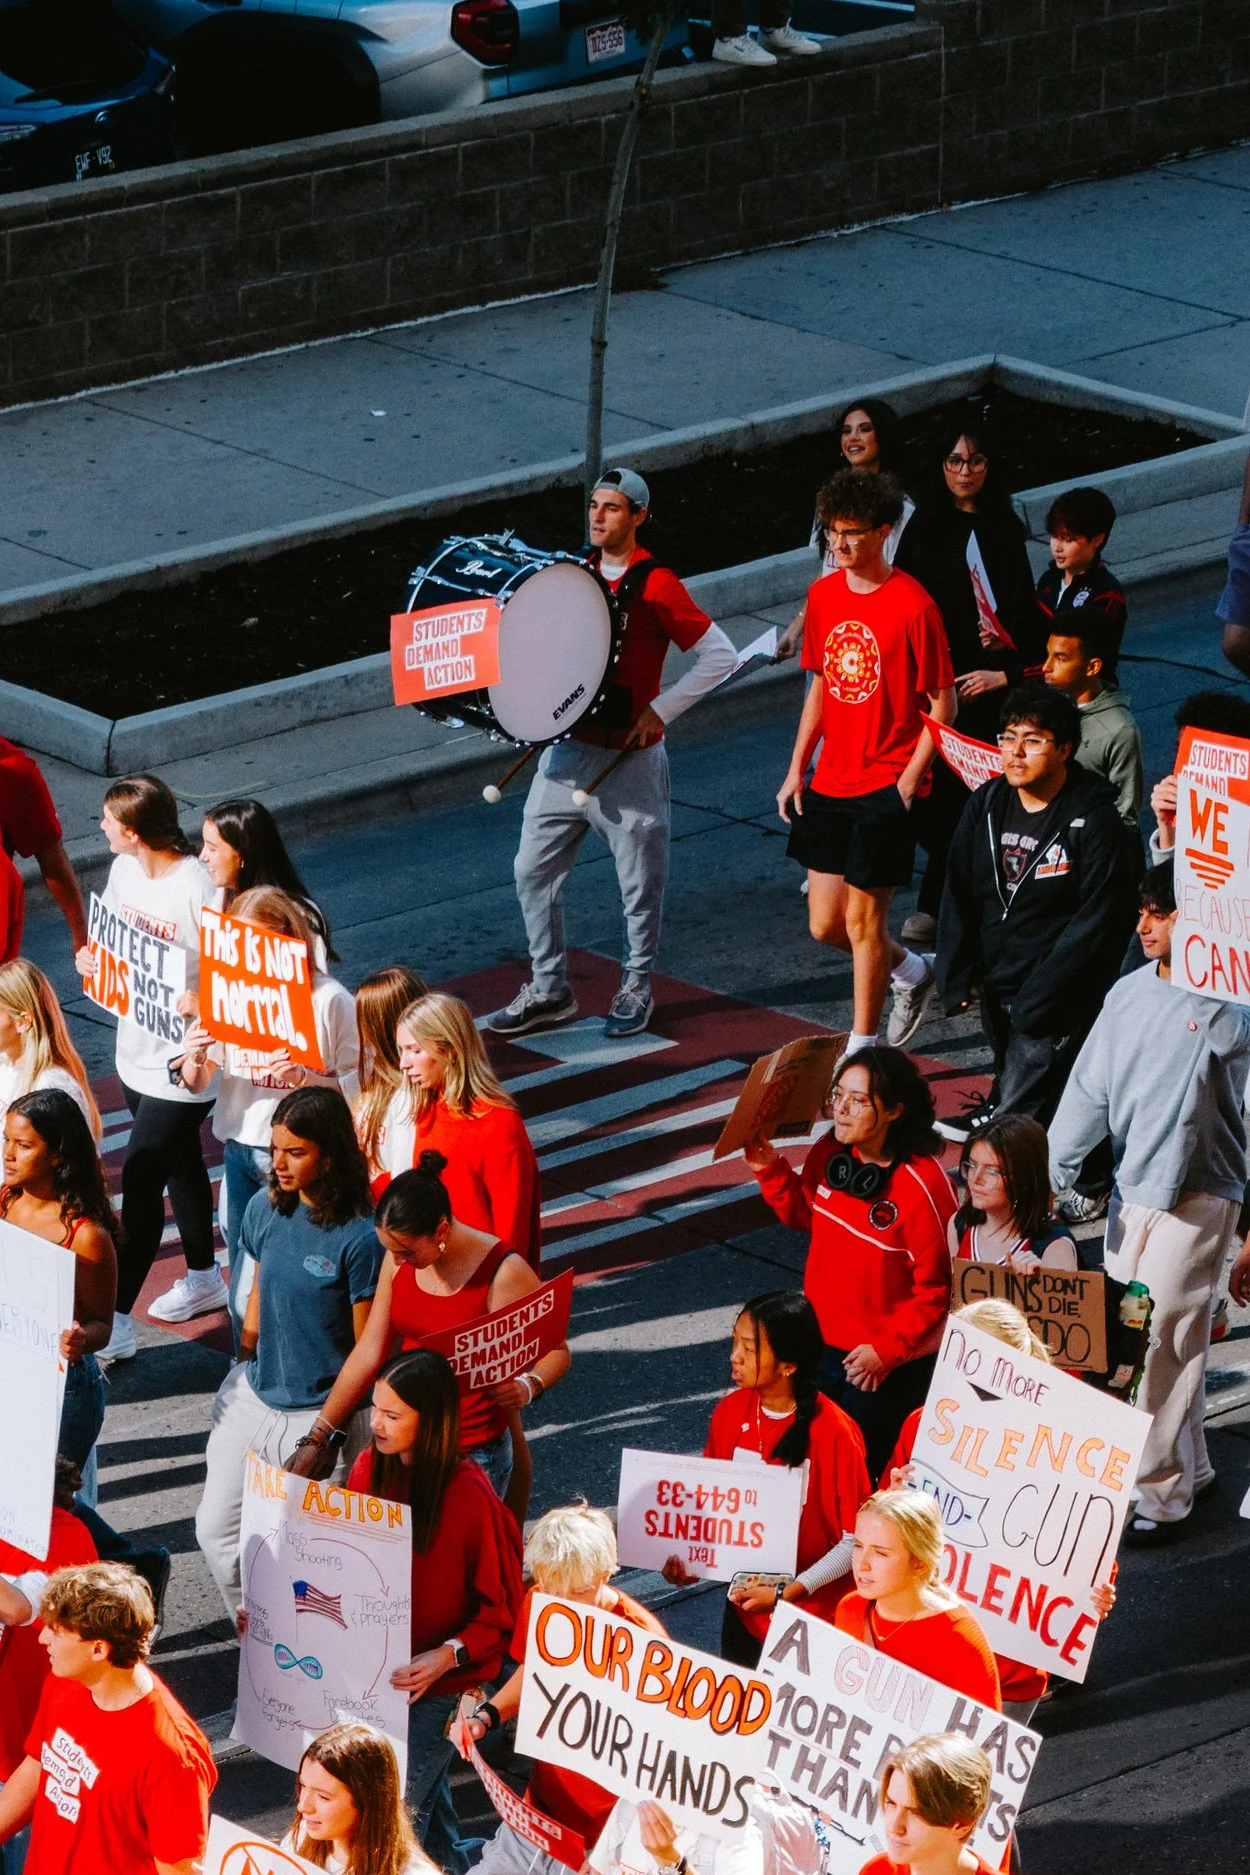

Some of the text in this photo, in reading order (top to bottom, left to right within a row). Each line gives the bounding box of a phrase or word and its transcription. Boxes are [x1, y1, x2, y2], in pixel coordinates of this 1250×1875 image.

[414, 612, 484, 642] STUDENTS
[407, 638, 459, 666] DEMAND
[427, 659, 473, 685] ACTION
[552, 684, 586, 721] EVANS
[1190, 742, 1247, 776] STUDENTS
[1190, 788, 1228, 855] WE
[90, 898, 170, 980] PROTECT
[201, 911, 240, 967] This
[264, 935, 308, 984] NOT
[133, 969, 174, 1007] NOT
[134, 997, 184, 1045] GUNS
[456, 1293, 553, 1353] STUDENTS
[450, 1332, 523, 1374] DEMAND
[473, 1341, 538, 1387] ACTION
[927, 1397, 1132, 1492] SILENCE
[302, 1480, 403, 1529] ACTION
[656, 1479, 741, 1515] 644-33
[644, 1509, 766, 1549] STUDENTS
[688, 1546, 718, 1569] Text
[535, 1602, 772, 1736] OUR BLOOD
[767, 1617, 1037, 1785] A GUN HAS
[532, 1671, 634, 1778] YOUR
[635, 1732, 756, 1828] HANDS
[766, 1728, 881, 1826] THAN
